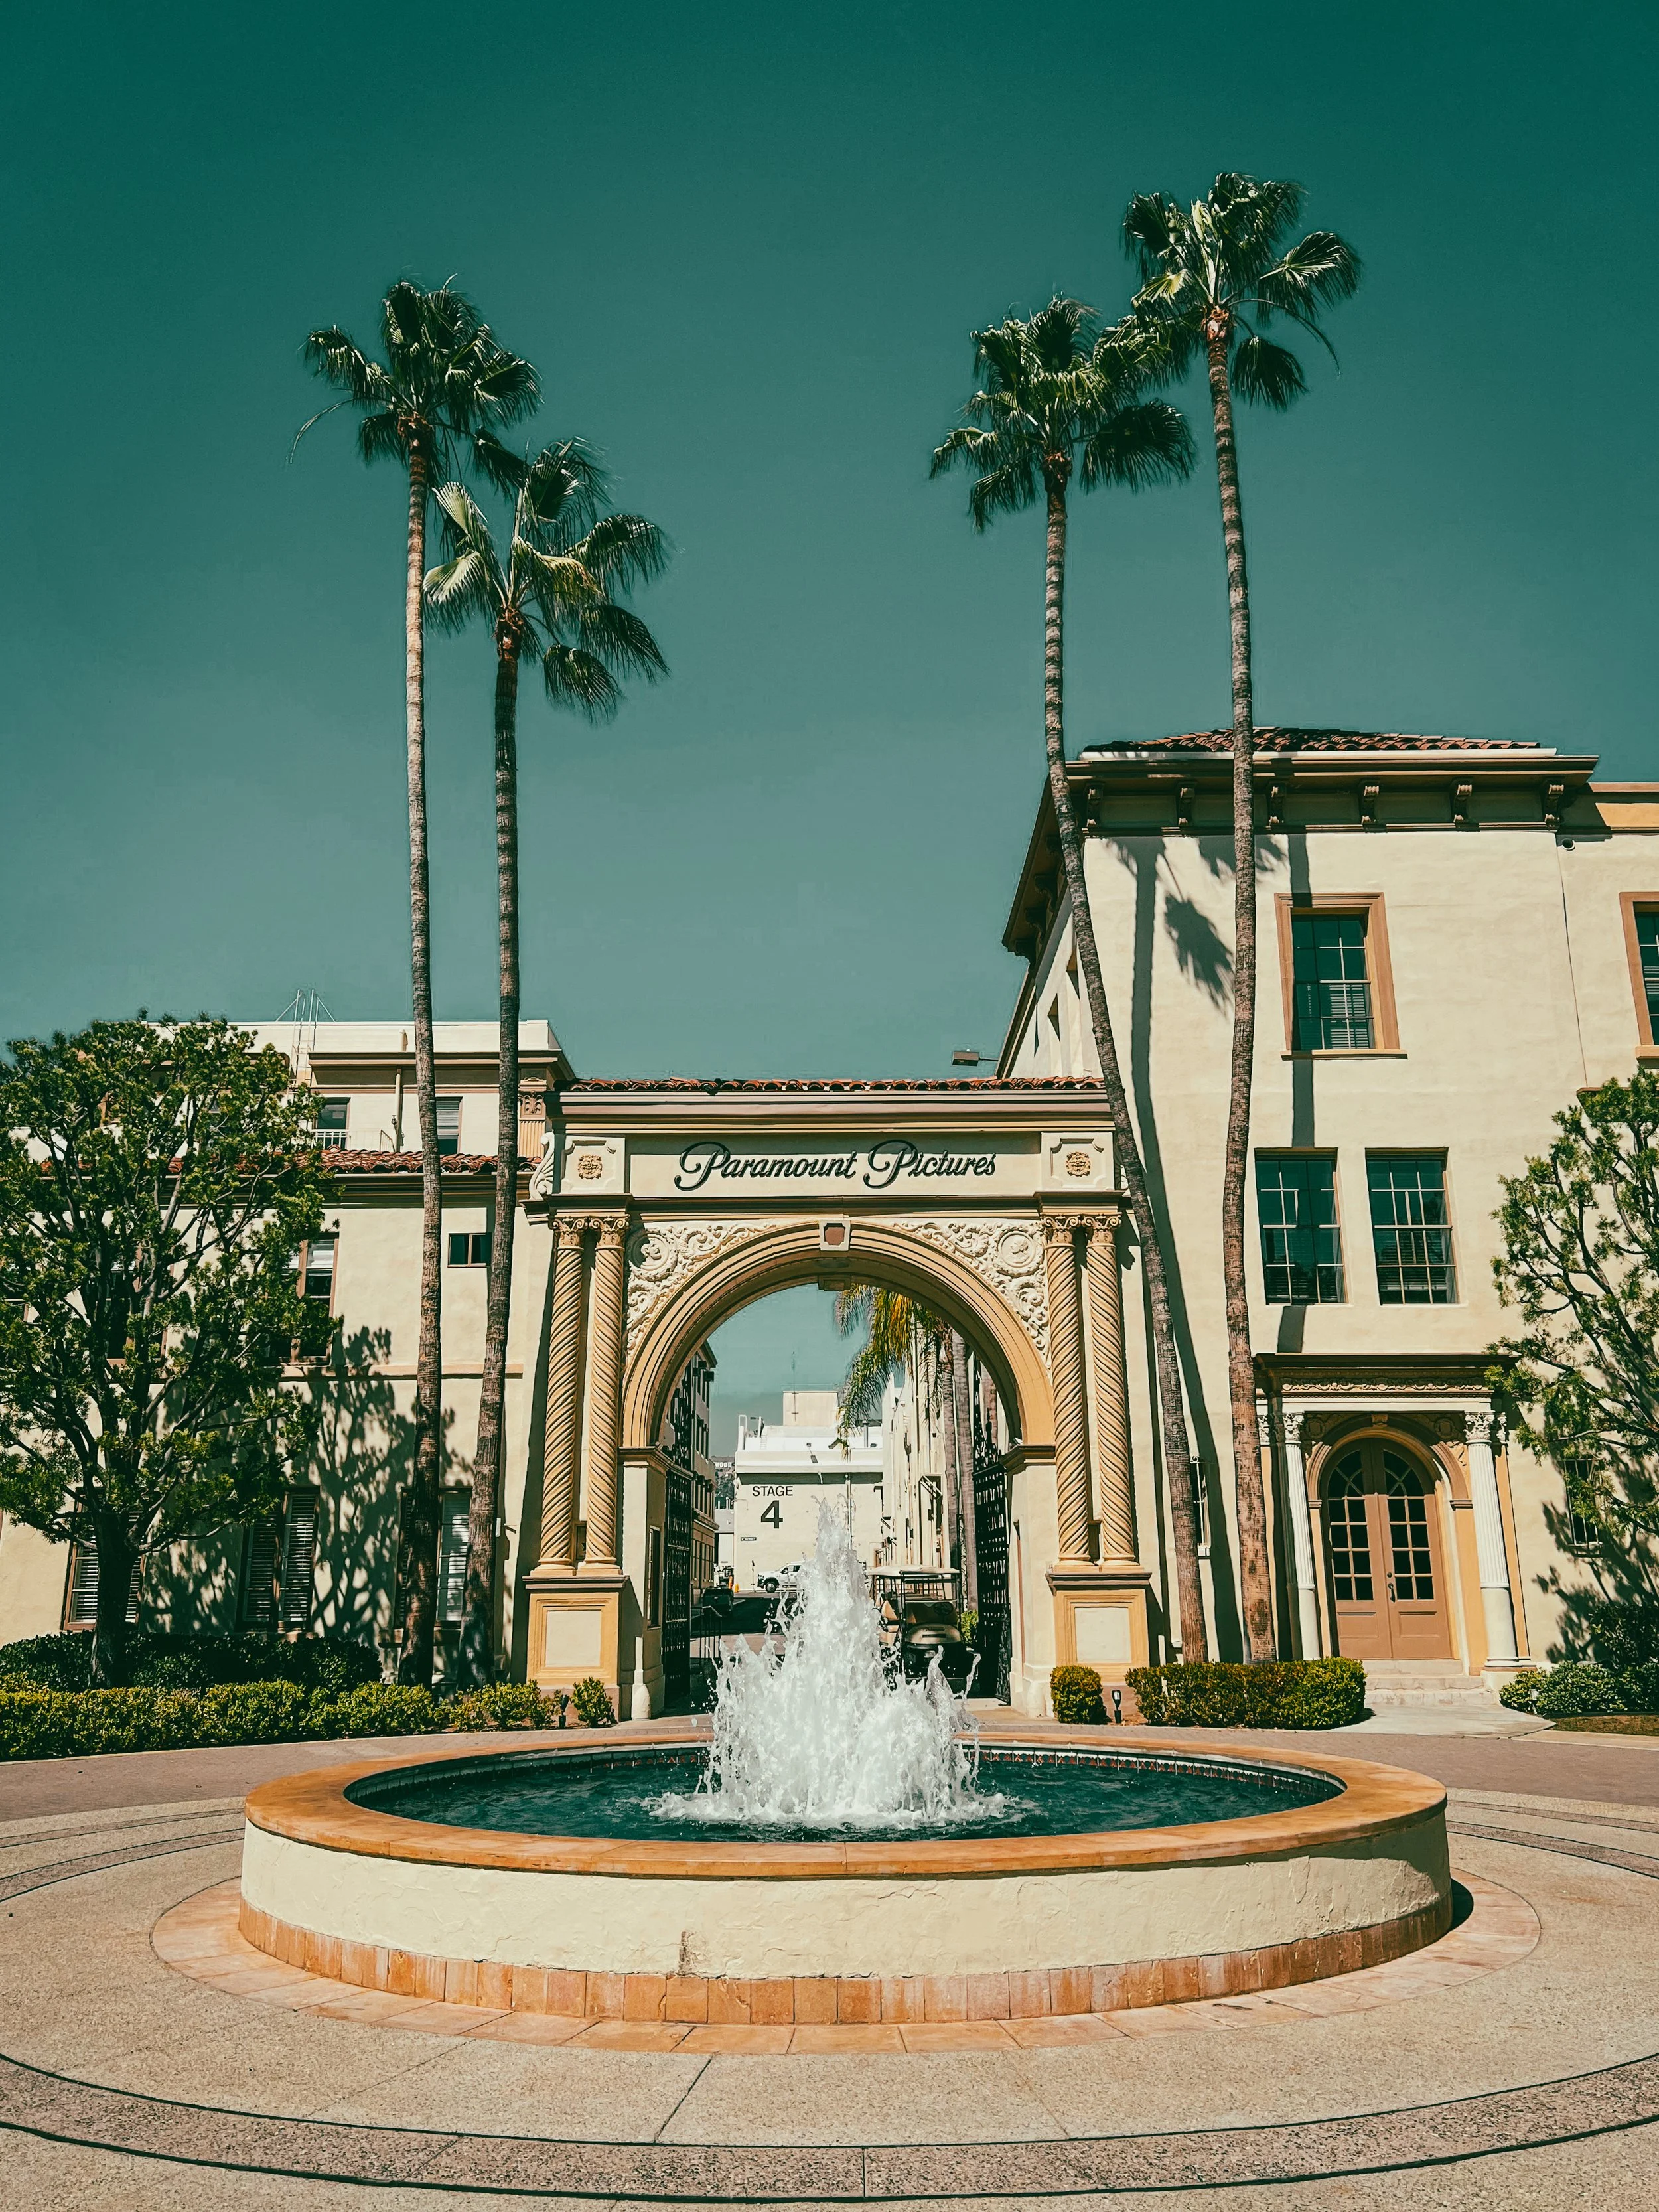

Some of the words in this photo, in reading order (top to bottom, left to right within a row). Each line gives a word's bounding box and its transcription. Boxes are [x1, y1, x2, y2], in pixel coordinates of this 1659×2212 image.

[674, 1141, 857, 1191] Paramount
[863, 1139, 997, 1189] Pictures
[752, 1485, 794, 1497] STAGE
[760, 1500, 784, 1529] 4
